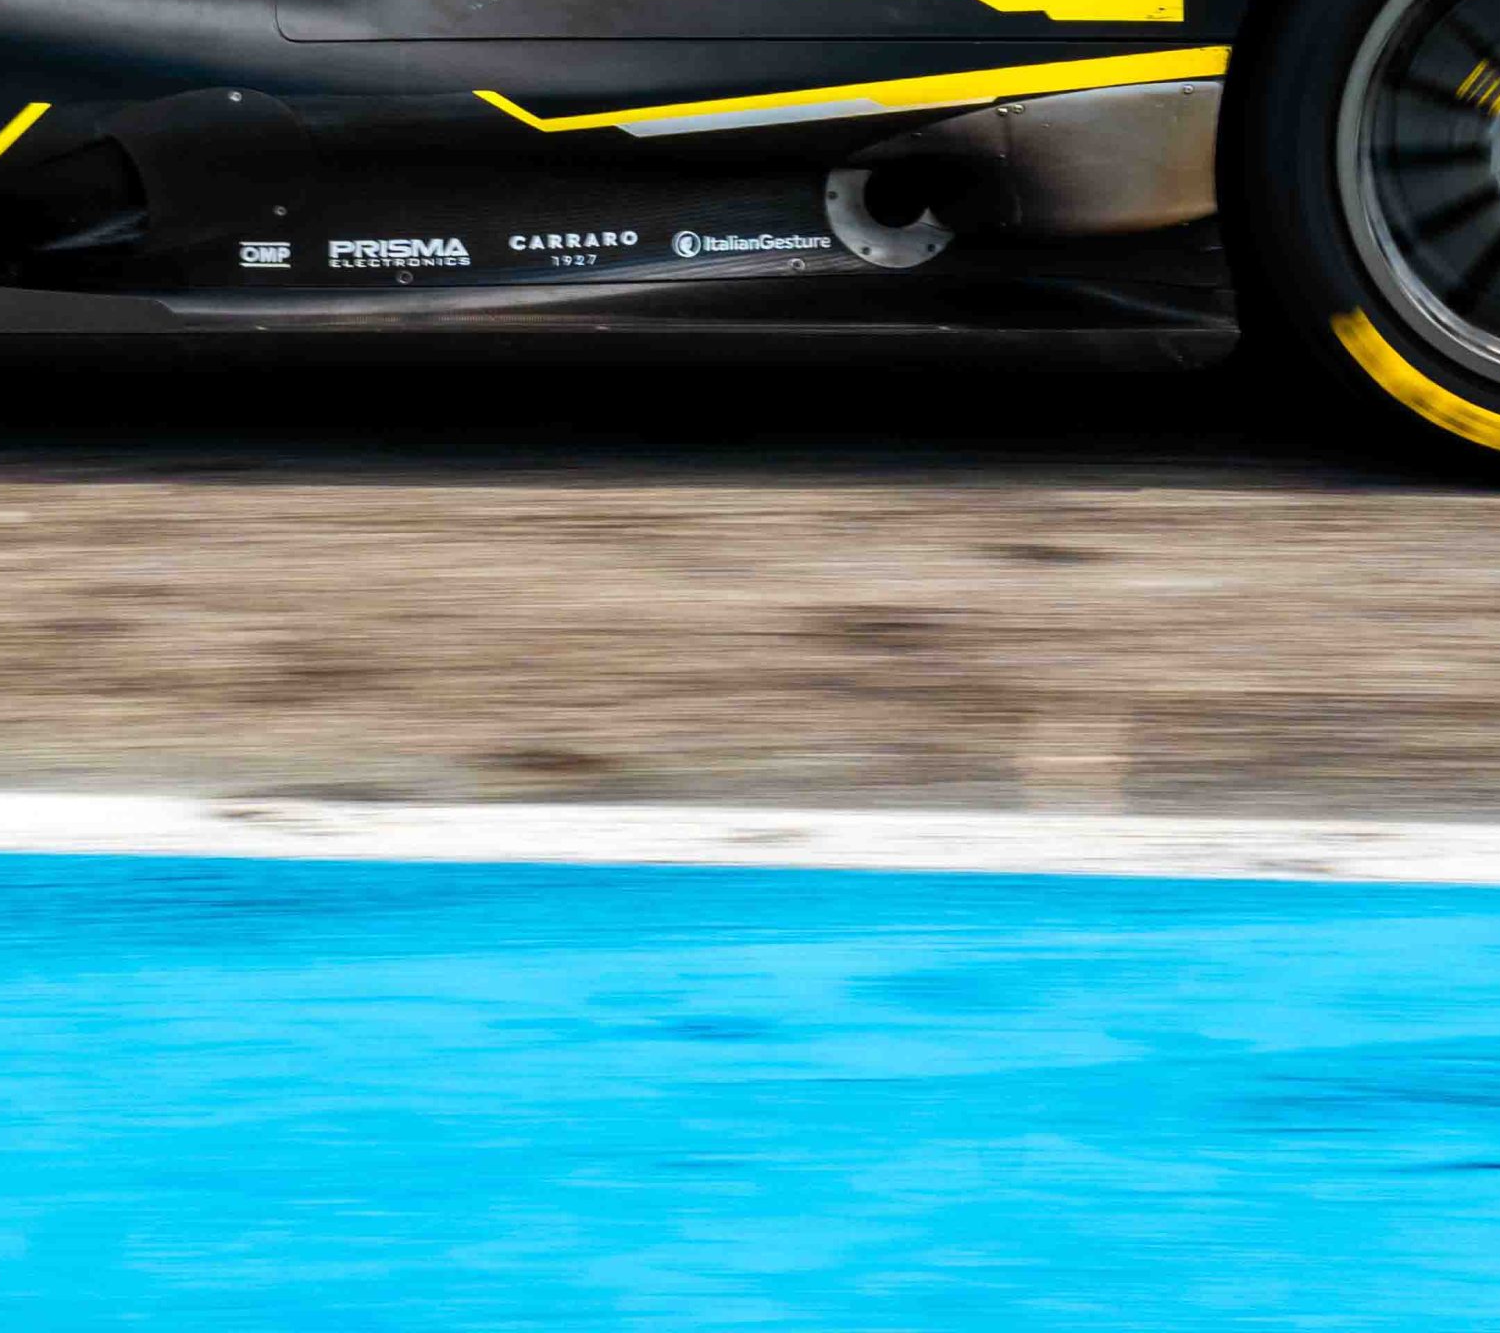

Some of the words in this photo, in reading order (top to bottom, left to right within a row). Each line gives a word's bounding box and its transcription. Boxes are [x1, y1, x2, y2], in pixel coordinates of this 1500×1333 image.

[328, 237, 470, 258] PRISMA
[508, 230, 639, 251] CARRARO
[240, 245, 291, 265] OMP
[328, 257, 471, 268] ELECTRONICS
[551, 254, 597, 267] 1927
